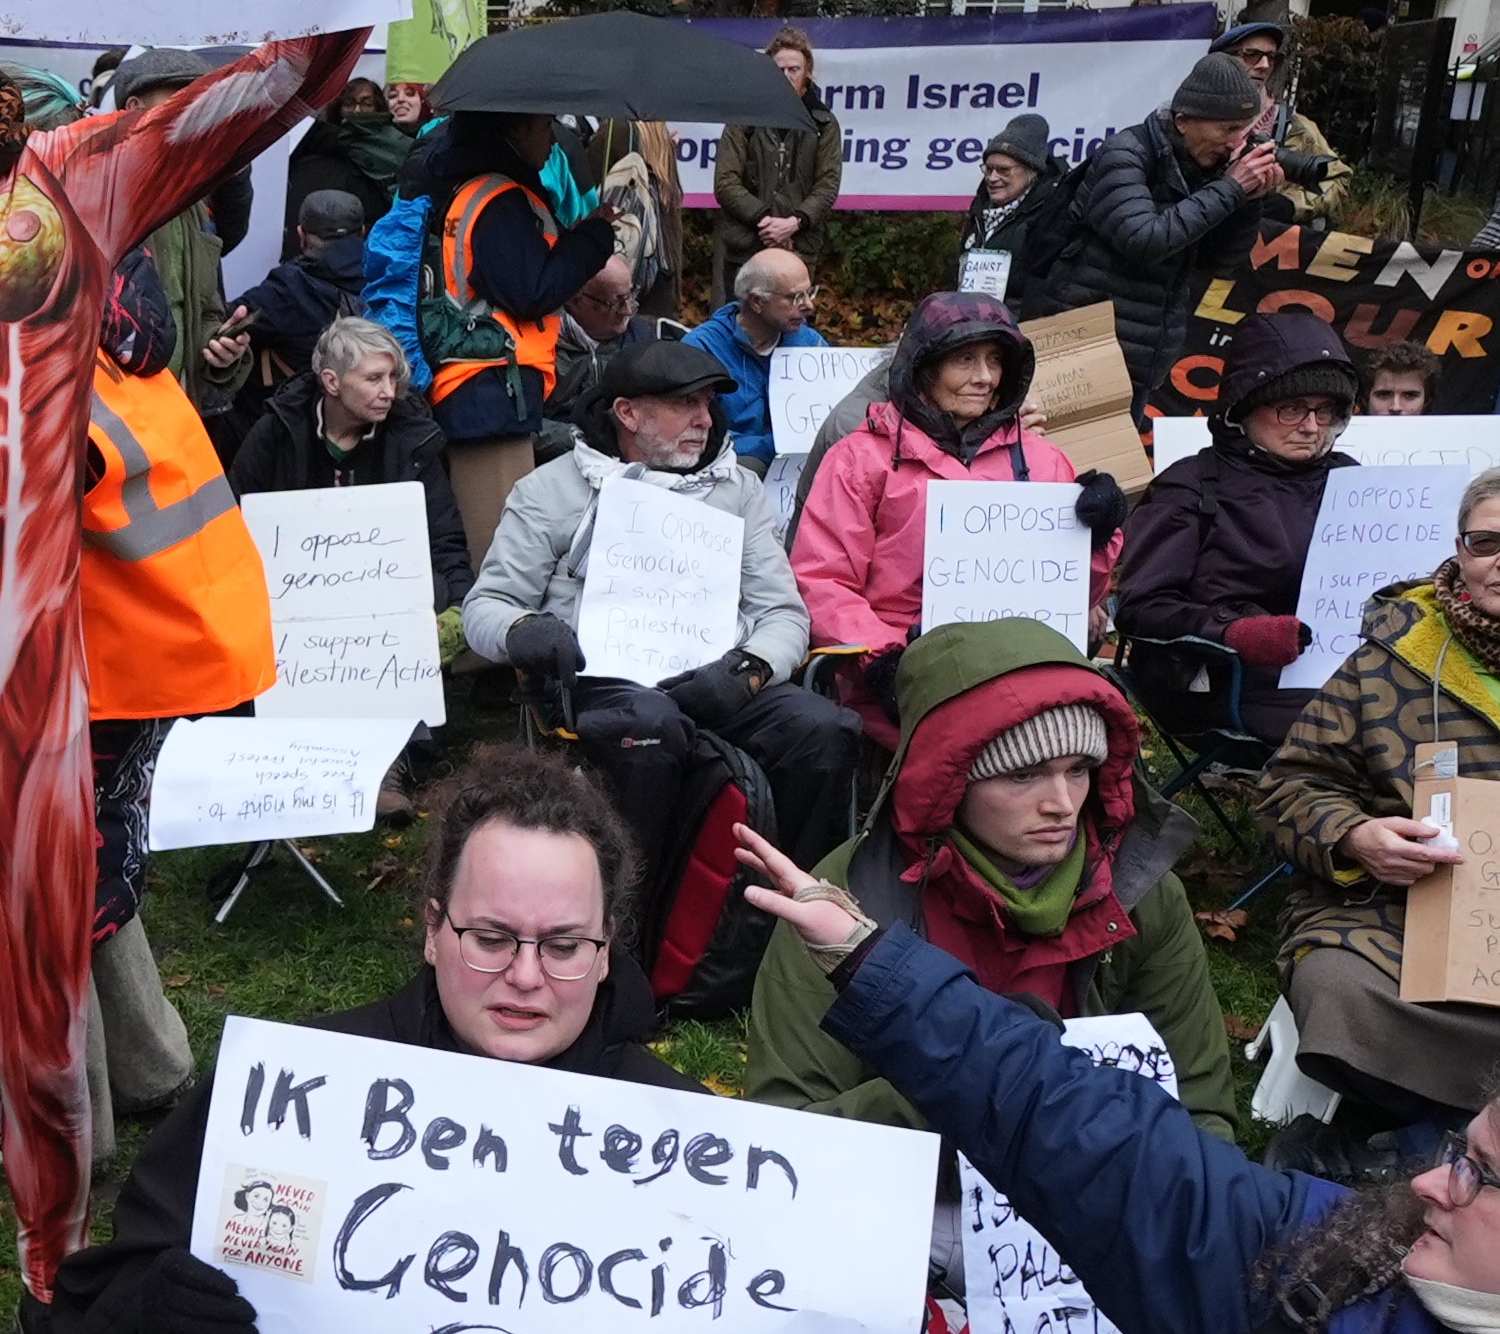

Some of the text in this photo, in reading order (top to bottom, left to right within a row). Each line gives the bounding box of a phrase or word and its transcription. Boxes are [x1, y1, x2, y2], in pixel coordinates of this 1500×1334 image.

[907, 73, 1039, 110] Israel
[843, 128, 911, 170] ing
[964, 259, 1003, 273] GAINST
[1250, 223, 1464, 301] MEN
[961, 277, 976, 290] ZA
[1194, 279, 1494, 359] LOUR
[1348, 486, 1433, 511] OPPOSE
[964, 503, 1077, 535] OPPOSE
[1320, 522, 1441, 548] GENOCIDE
[299, 526, 406, 563] oppose
[271, 559, 423, 601] genocide
[927, 556, 1081, 588] GENOCIDE
[304, 631, 401, 658] support
[236, 791, 286, 820] right
[293, 786, 317, 812] my
[238, 1060, 800, 1202] IK Ben tegen
[244, 1250, 304, 1272] ANYONE
[332, 1181, 800, 1321] Genocide
